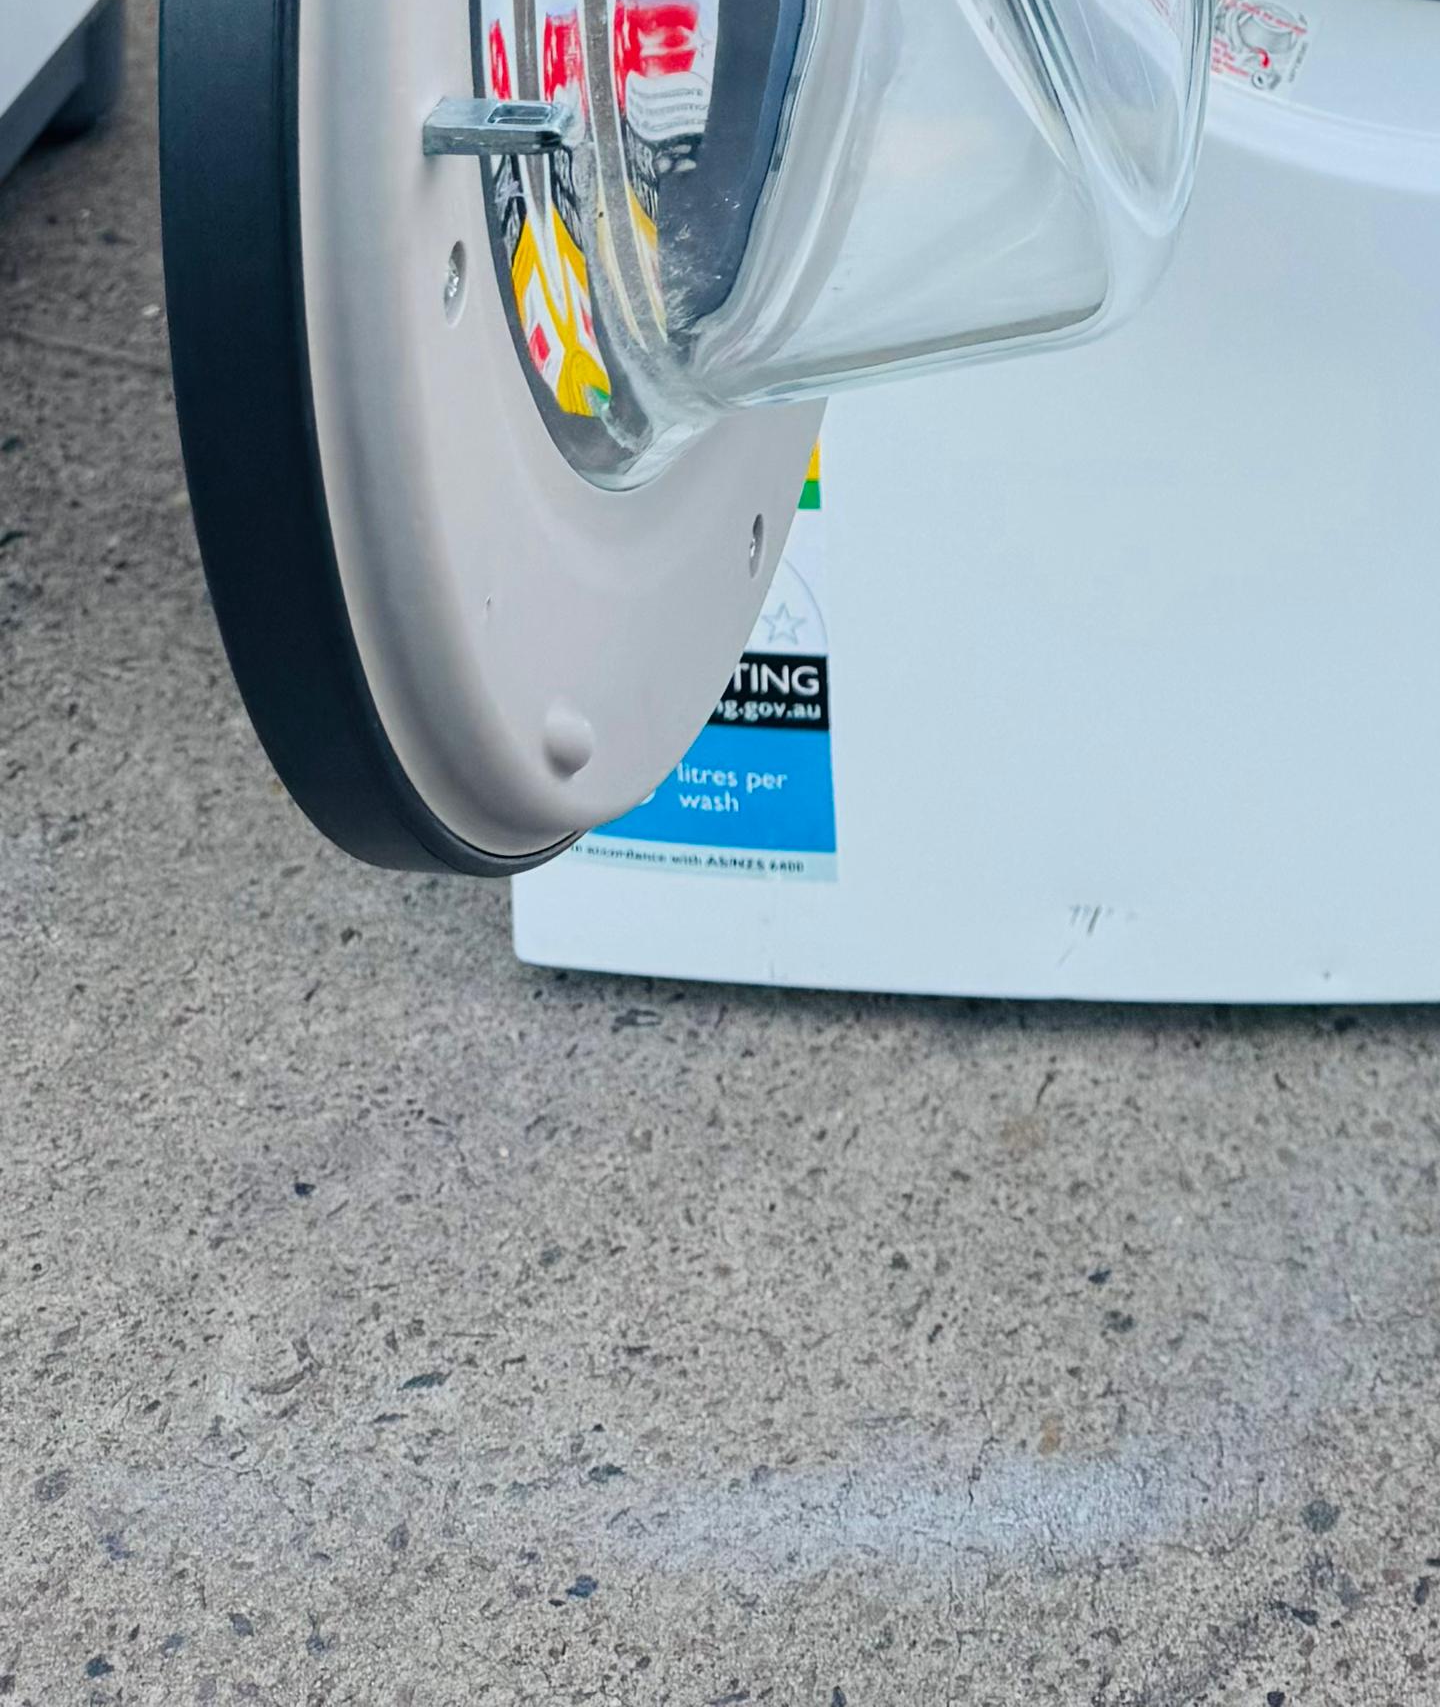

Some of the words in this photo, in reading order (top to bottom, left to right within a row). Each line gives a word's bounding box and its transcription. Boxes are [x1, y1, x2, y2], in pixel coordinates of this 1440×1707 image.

[733, 662, 820, 696] TING
[717, 699, 822, 722] g.gov.au
[676, 762, 738, 787] litres
[746, 771, 788, 794] per
[679, 791, 739, 812] wash
